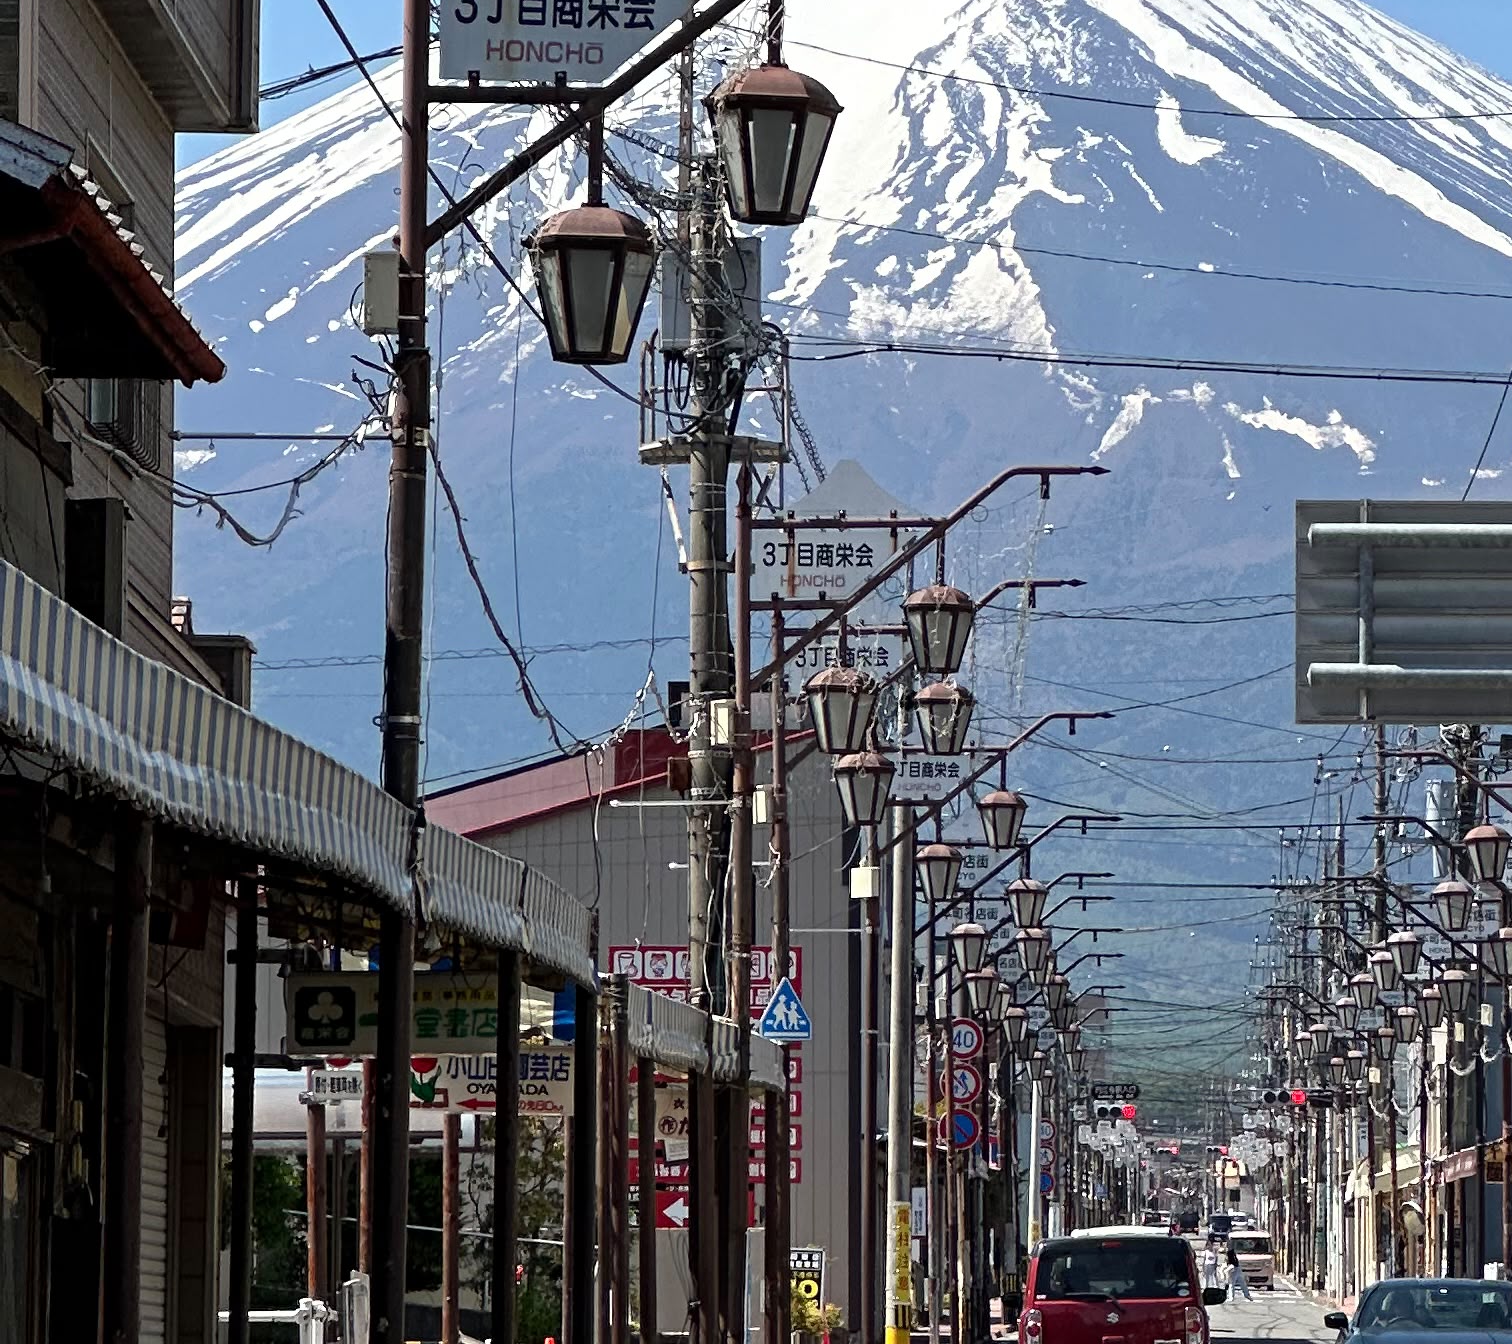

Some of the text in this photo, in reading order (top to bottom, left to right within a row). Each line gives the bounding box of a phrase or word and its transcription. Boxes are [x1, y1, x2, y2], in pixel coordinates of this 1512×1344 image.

[762, 542, 873, 568] 3丁目商栄会
[894, 761, 960, 778] 丁目商栄会
[953, 1031, 974, 1048] 40
[467, 1083, 548, 1094] OYAADA
